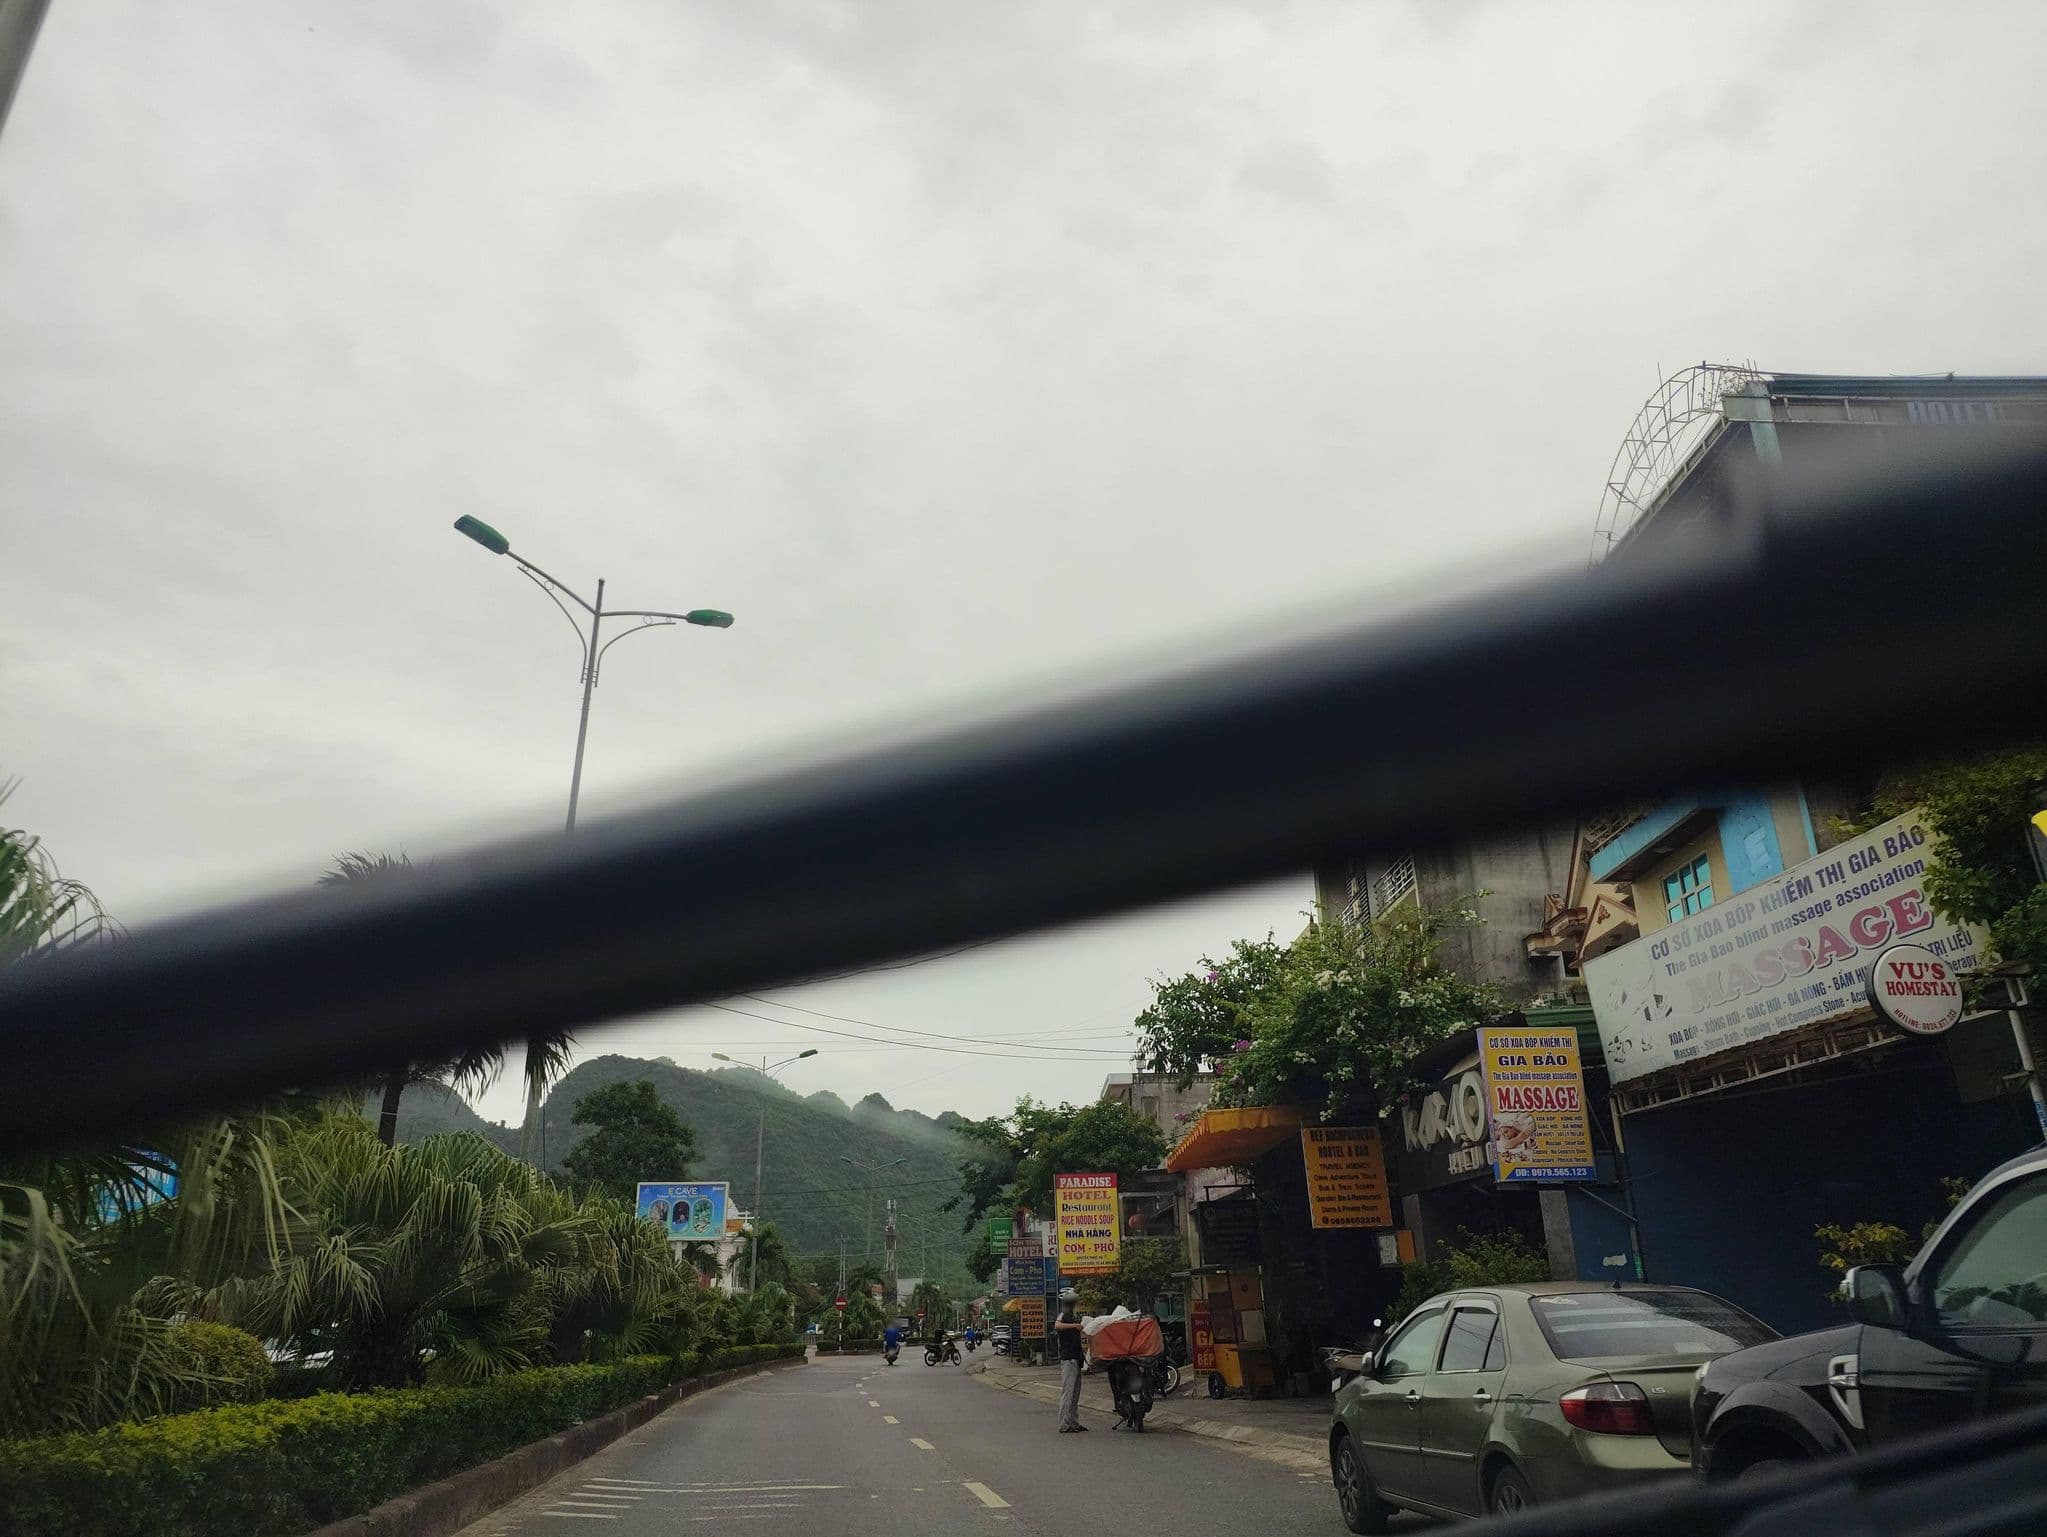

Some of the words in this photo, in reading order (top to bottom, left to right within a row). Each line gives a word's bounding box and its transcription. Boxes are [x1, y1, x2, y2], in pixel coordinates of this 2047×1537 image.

[1694, 917, 1723, 942] XOA
[1759, 876, 1814, 915] KHIẾM
[1816, 861, 1847, 888] THỊ
[1848, 845, 1881, 874] GIA
[1884, 825, 1925, 859] BẢO
[1665, 961, 1687, 977] The
[1709, 941, 1733, 960] Bao
[1735, 925, 1769, 950] blind
[1773, 899, 1832, 935] massage
[1836, 858, 1925, 908] association
[1687, 889, 1934, 1012] MASSAGE
[1888, 962, 1946, 980] VU'S
[1886, 981, 1958, 996] HOMESTAY
[1823, 997, 1846, 1012] Stone
[1511, 1037, 1524, 1049] XOA
[1539, 1033, 1561, 1048] KHIẾM
[1562, 1037, 1573, 1051] THỊ
[1669, 1031, 1684, 1046] XOA
[1498, 1055, 1528, 1066] GIA
[1532, 1051, 1568, 1066] BẢO
[1497, 1086, 1579, 1110] MASSAGE
[1059, 1177, 1112, 1188] PARADISE
[1063, 1190, 1111, 1200] HOTEL
[1062, 1203, 1111, 1212] Restaurant
[1061, 1215, 1074, 1225] RICE
[1076, 1215, 1097, 1225] NOODLE
[1099, 1214, 1114, 1224] SOUP
[1065, 1228, 1084, 1238] NHÀ
[1086, 1227, 1111, 1238] HÀNG
[1009, 1247, 1043, 1257] HOTEL
